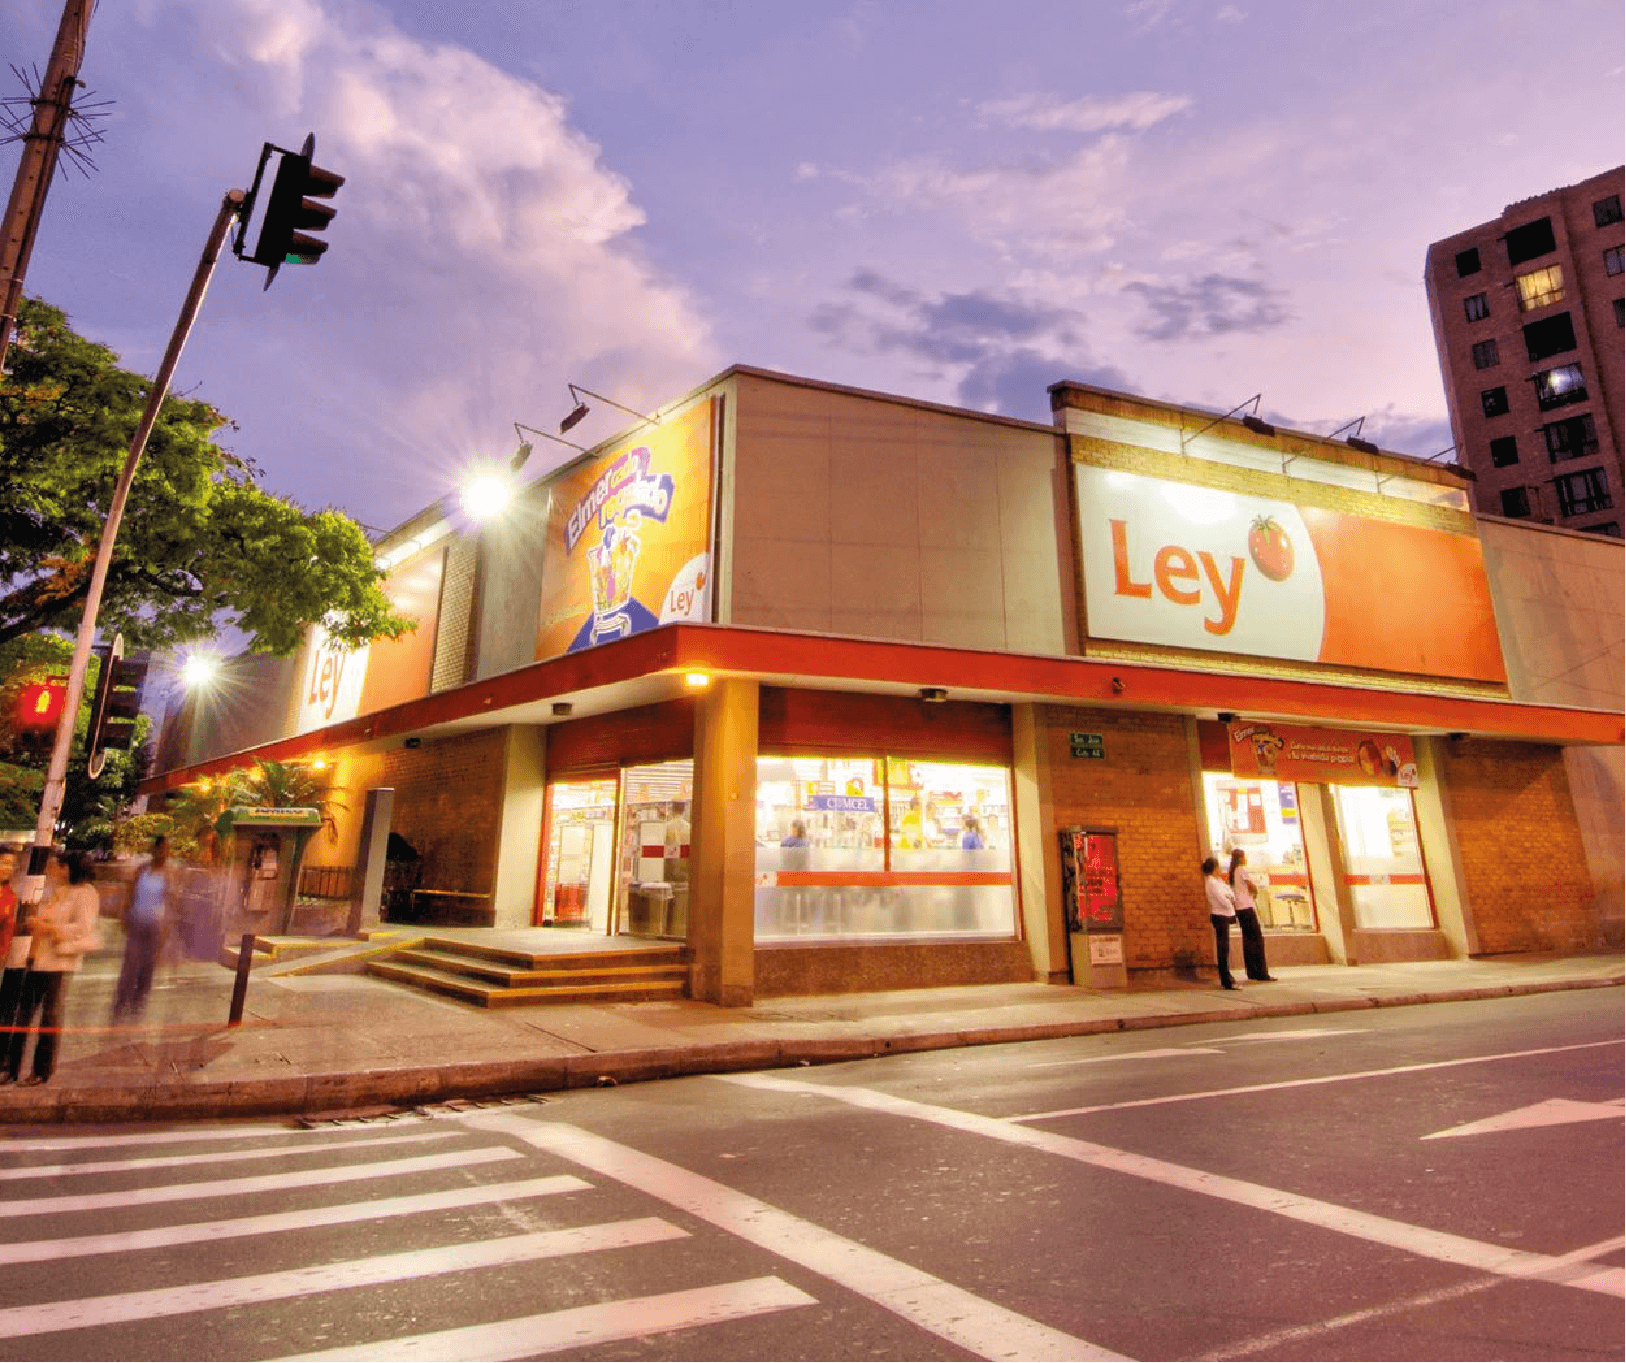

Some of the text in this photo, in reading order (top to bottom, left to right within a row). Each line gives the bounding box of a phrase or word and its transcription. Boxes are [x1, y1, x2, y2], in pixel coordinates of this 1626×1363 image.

[670, 588, 695, 616] Ley
[1109, 519, 1246, 636] Ley
[308, 650, 347, 720] Ley
